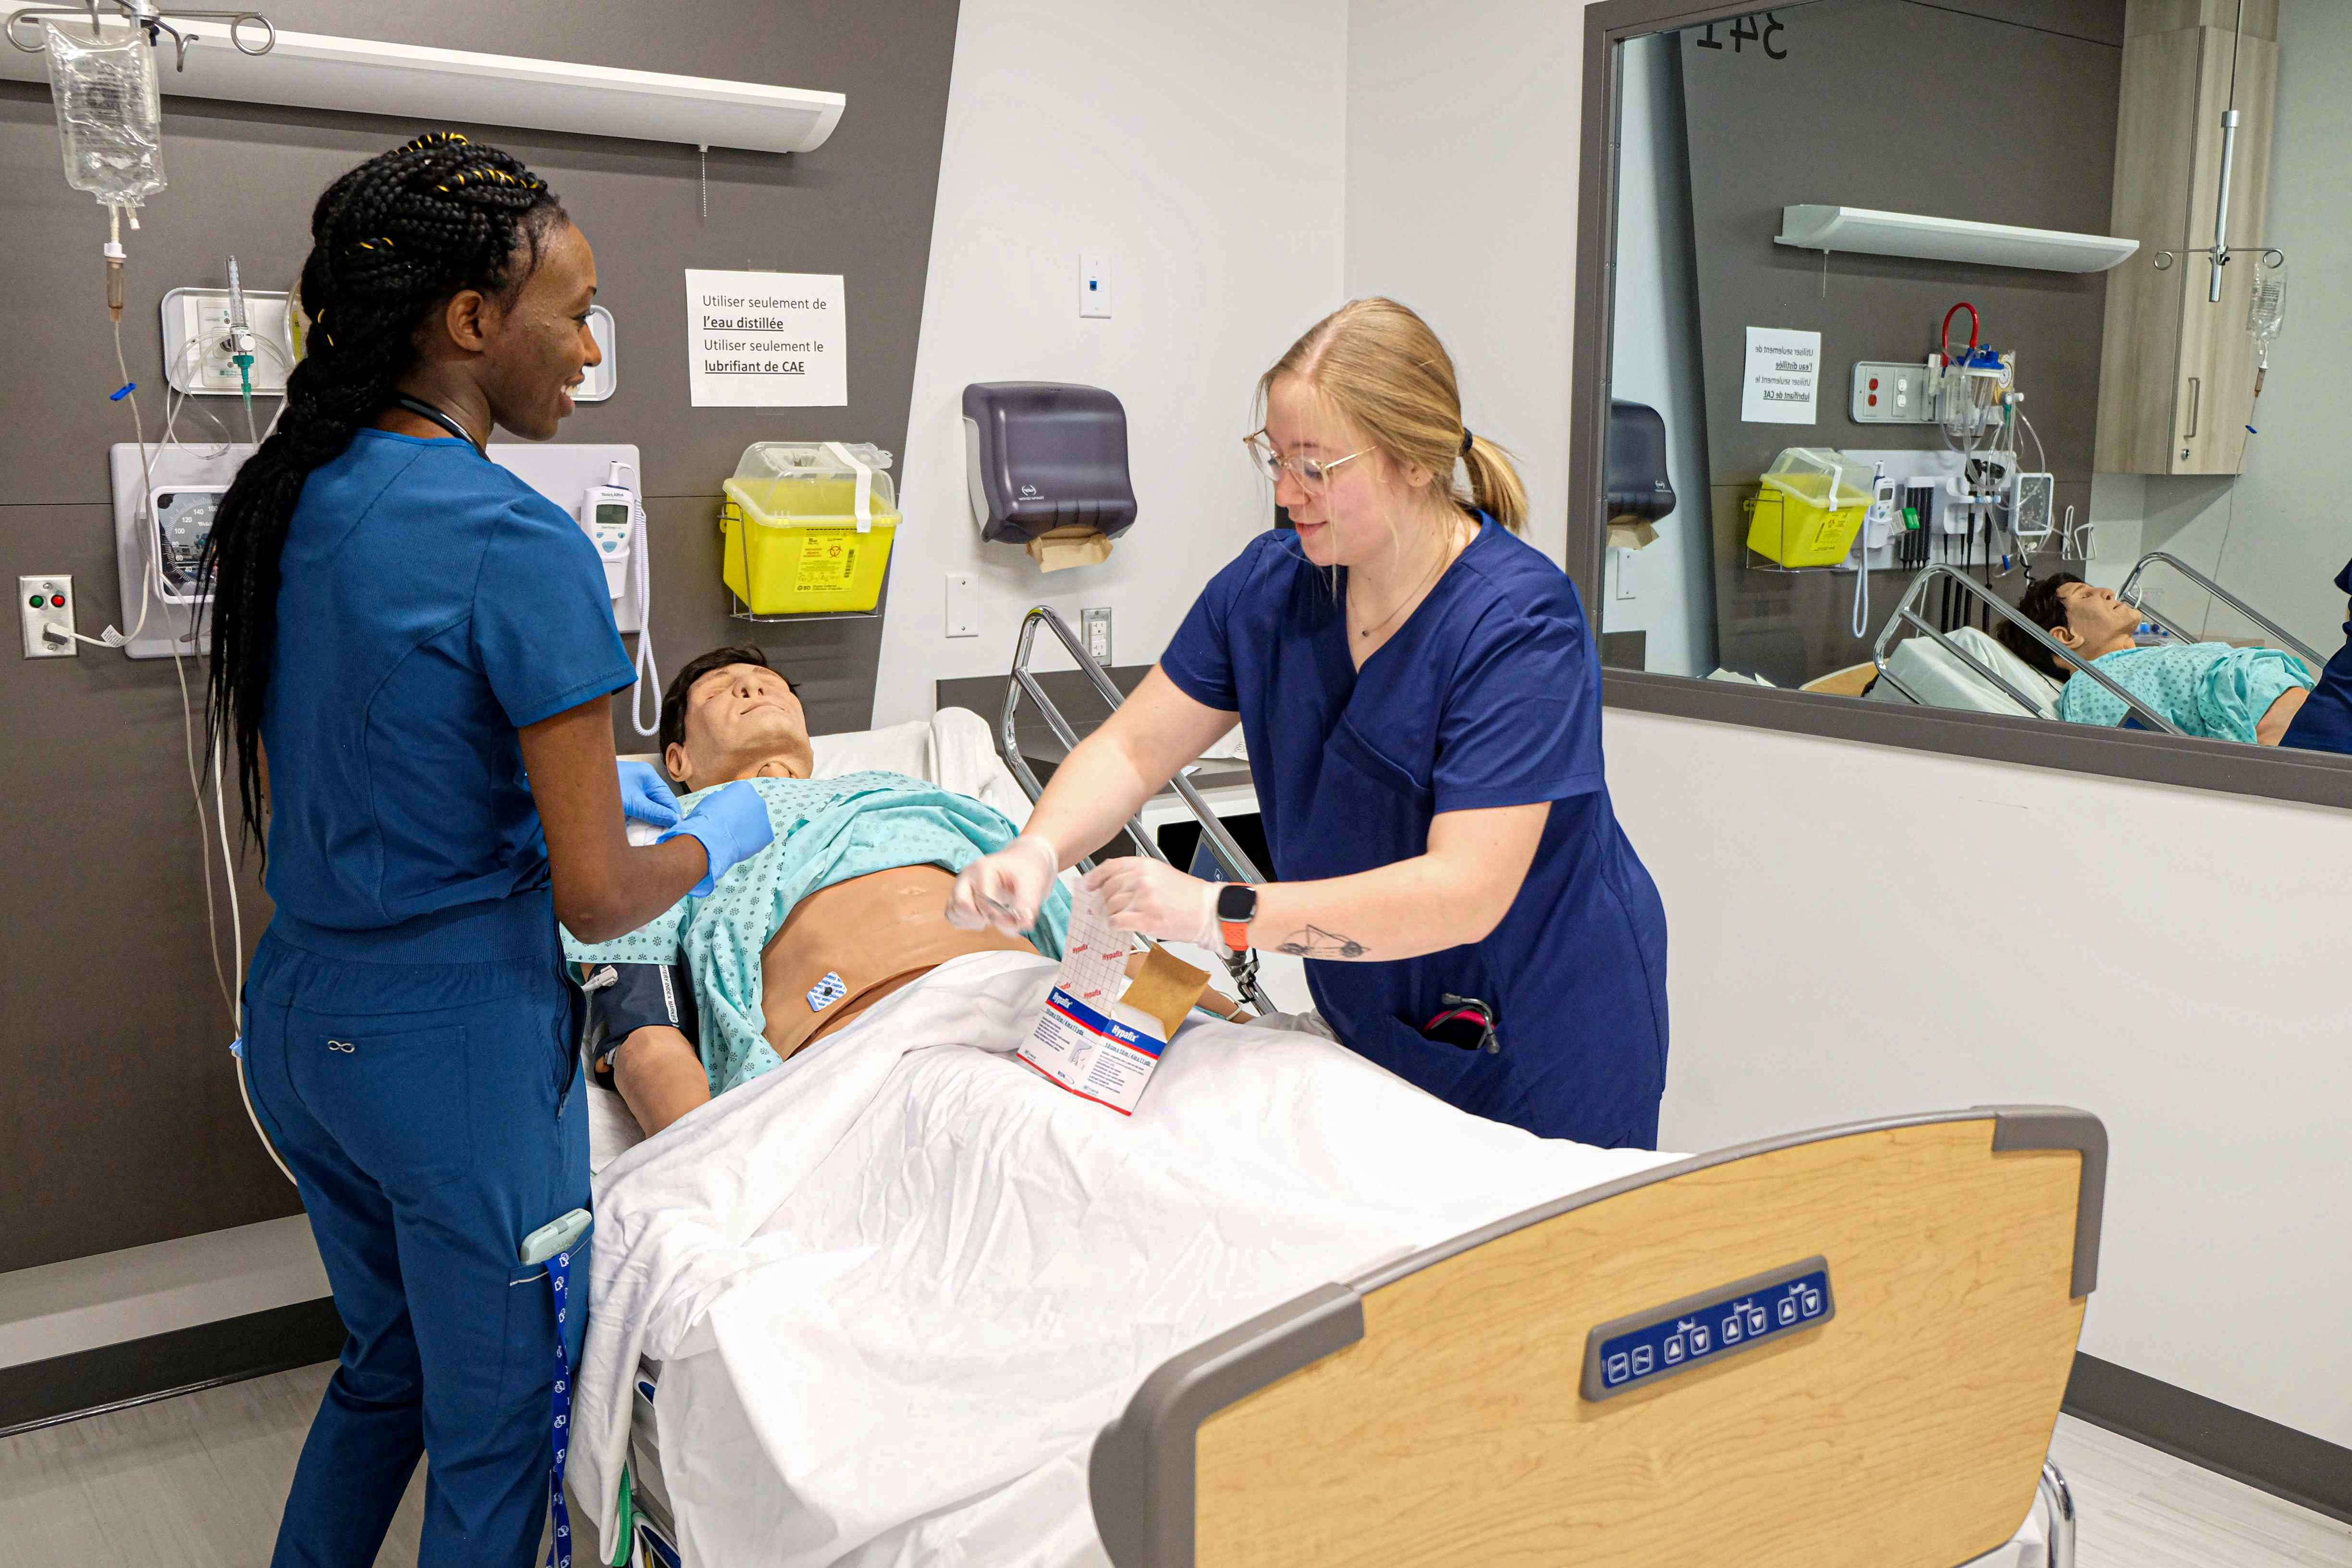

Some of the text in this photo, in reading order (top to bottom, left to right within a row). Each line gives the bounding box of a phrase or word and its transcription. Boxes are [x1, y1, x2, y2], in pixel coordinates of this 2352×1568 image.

[703, 295, 827, 310] Utiliser seulement de
[703, 316, 784, 329] l'eau distillée
[704, 339, 824, 352] Utiliser seulement le
[705, 360, 805, 372] lubrifiant de CAE
[1072, 943, 1088, 955] Hypafix
[1102, 950, 1123, 961] Hypafix
[1052, 992, 1072, 1008] Hypafix
[1084, 989, 1102, 999] Hypafix
[668, 1001, 677, 1022] MARKER
[1111, 1025, 1138, 1042] Hypafix
